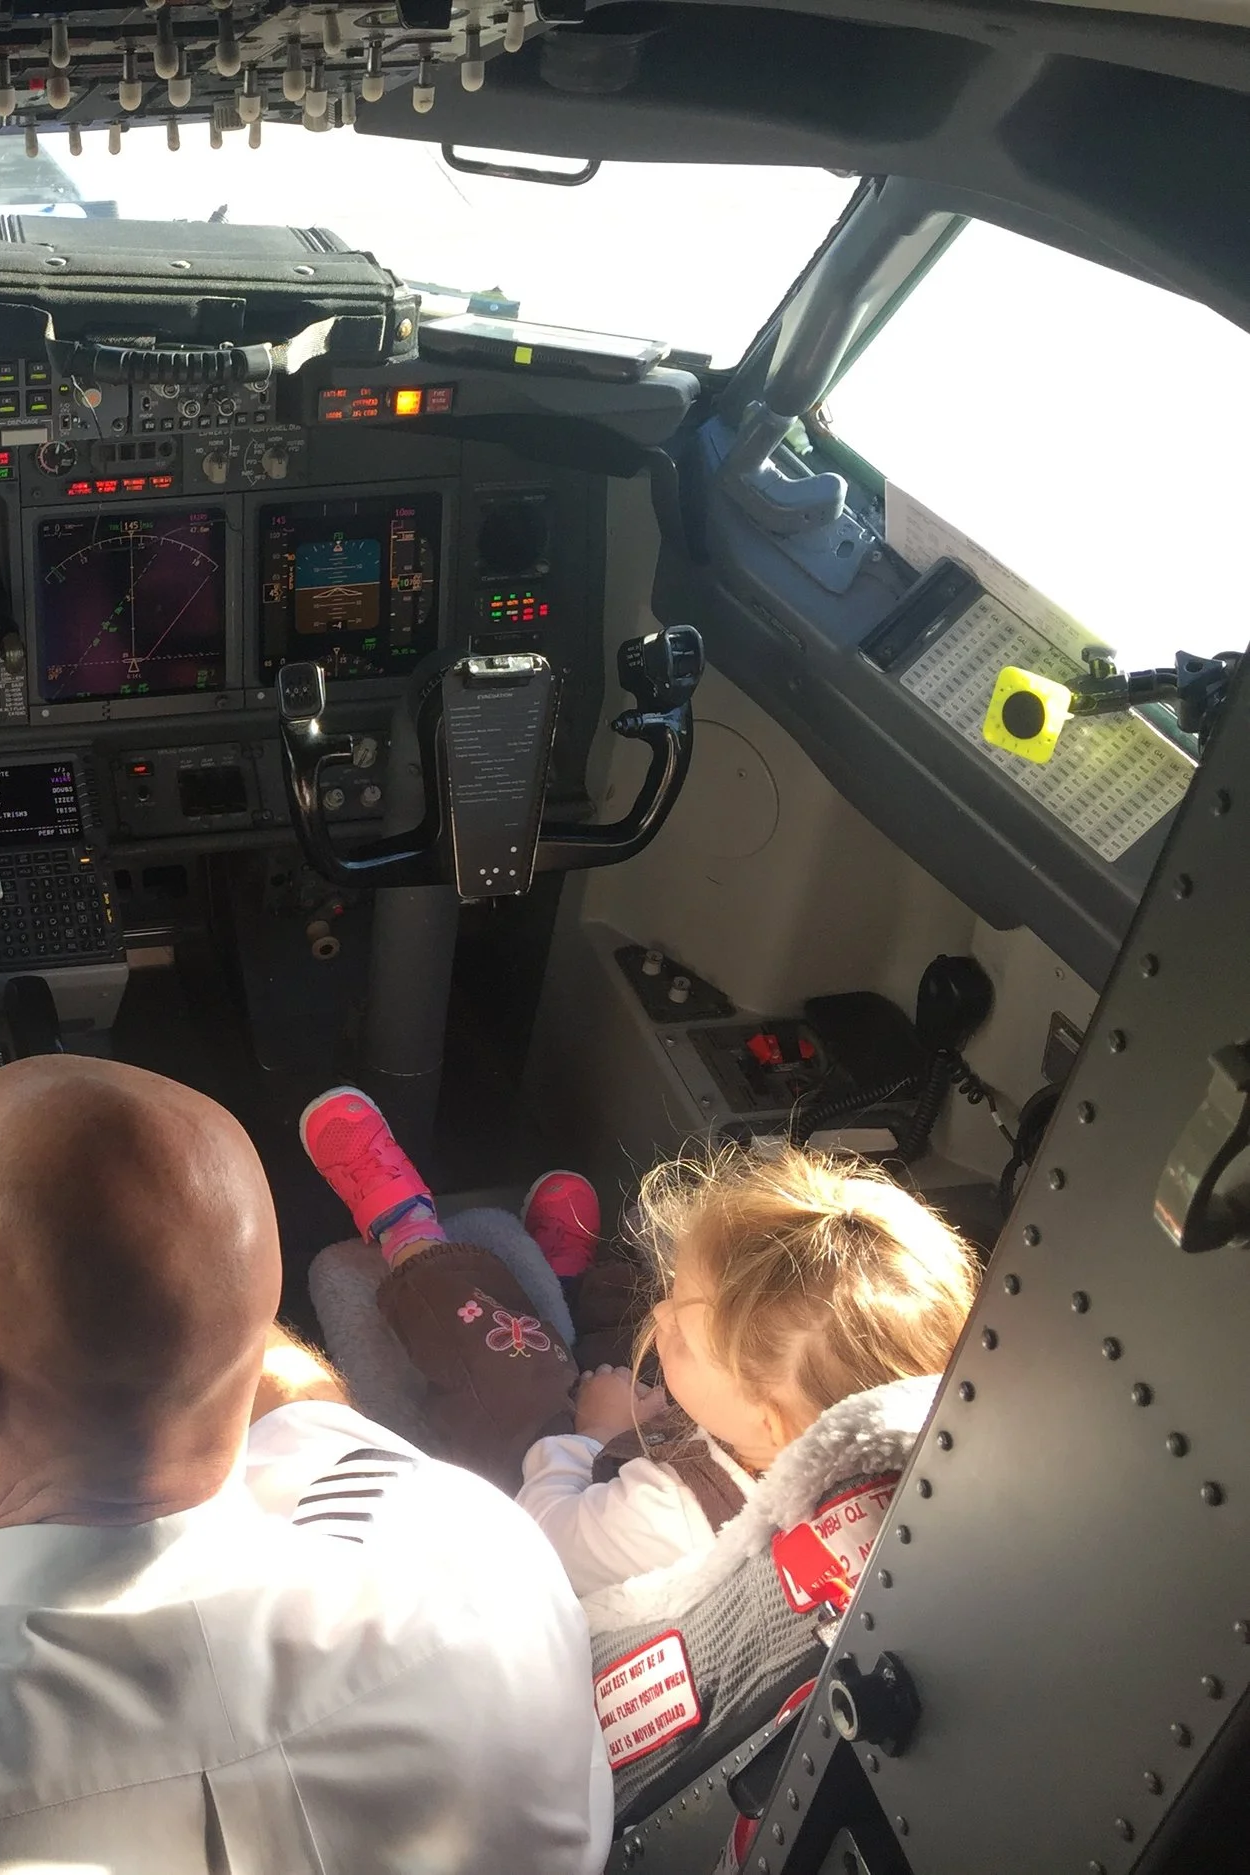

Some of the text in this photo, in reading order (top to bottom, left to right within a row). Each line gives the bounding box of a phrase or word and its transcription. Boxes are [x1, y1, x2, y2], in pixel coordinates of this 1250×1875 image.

[123, 521, 139, 531] 145
[844, 1502, 868, 1524] TO
[599, 1649, 665, 1700] BACK REST MUST BE IN
[616, 1697, 640, 1721] FLIGHT
[639, 1681, 665, 1708] POSITION
[663, 1669, 687, 1692] WHEN
[609, 1702, 687, 1757] SEAT IS MOVING OUTBOARD
